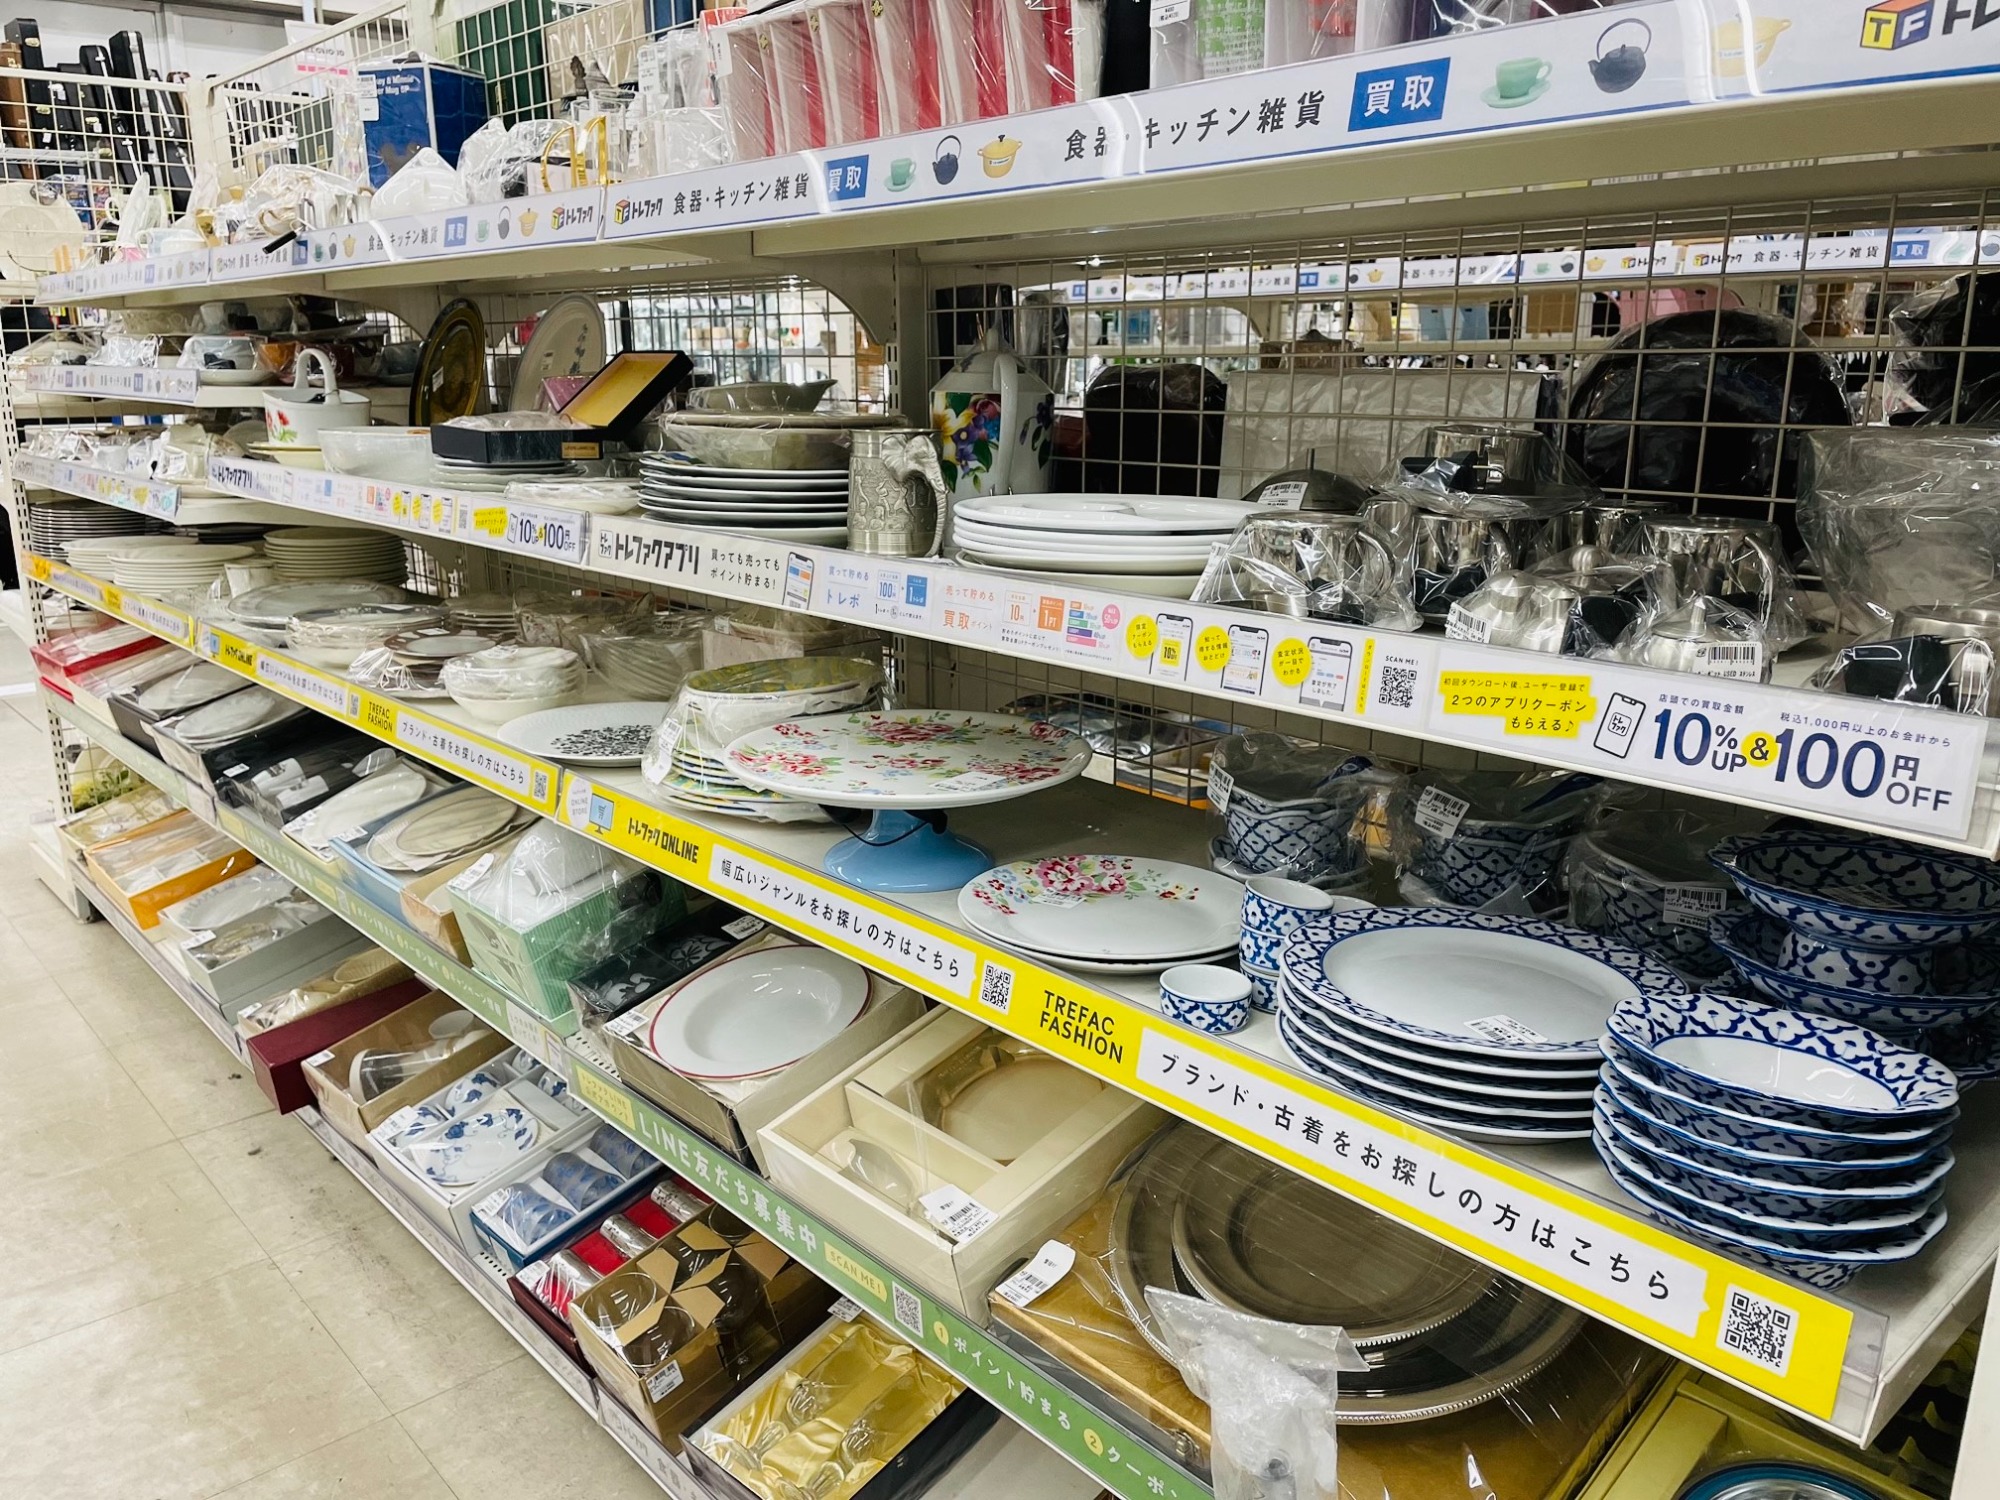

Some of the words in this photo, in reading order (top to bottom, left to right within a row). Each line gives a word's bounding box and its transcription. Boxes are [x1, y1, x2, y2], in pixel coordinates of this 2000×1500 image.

[1364, 75, 1435, 117] 買取
[631, 199, 663, 219] トレファク
[673, 173, 810, 216] 食器・キッチン雑貨
[828, 165, 862, 194] 買取
[368, 225, 439, 252] 食器キッチン雑貨
[565, 205, 593, 226] トレファク
[613, 532, 700, 575] トレファクアプリ
[711, 547, 781, 572] 買っても売っても
[710, 567, 776, 590] ポイント貯まる！
[827, 588, 861, 608] トレポ
[1277, 647, 1304, 658] 査定状況
[1385, 655, 1403, 663] SCAN
[368, 701, 391, 719] TREFAC
[1451, 694, 1587, 712] 2つのアプリクーポン
[1658, 693, 1745, 715] 店頭での買取金額
[367, 713, 393, 732] FASHION
[1780, 712, 1952, 747] 税込1,000円以上のお会計から
[402, 721, 525, 786] ブランド・古着をお探しの方はこちら
[1711, 750, 1748, 773] UP
[1750, 737, 1770, 761] &
[1886, 782, 1952, 811] OFF
[628, 817, 661, 846] トレファク
[661, 831, 699, 864] ONLINE
[720, 858, 960, 978] 幅広いジャンルをお探しの方はこちら
[1043, 990, 1116, 1036] TREFAC
[1039, 1013, 1123, 1065] FASHION
[638, 1111, 817, 1253] LINE友だち募集中
[1161, 1053, 1670, 1301] ブランド・古着をお探しの方はこちら
[830, 1249, 858, 1280] SCAN
[953, 1335, 1072, 1431] ポイント貯まる
